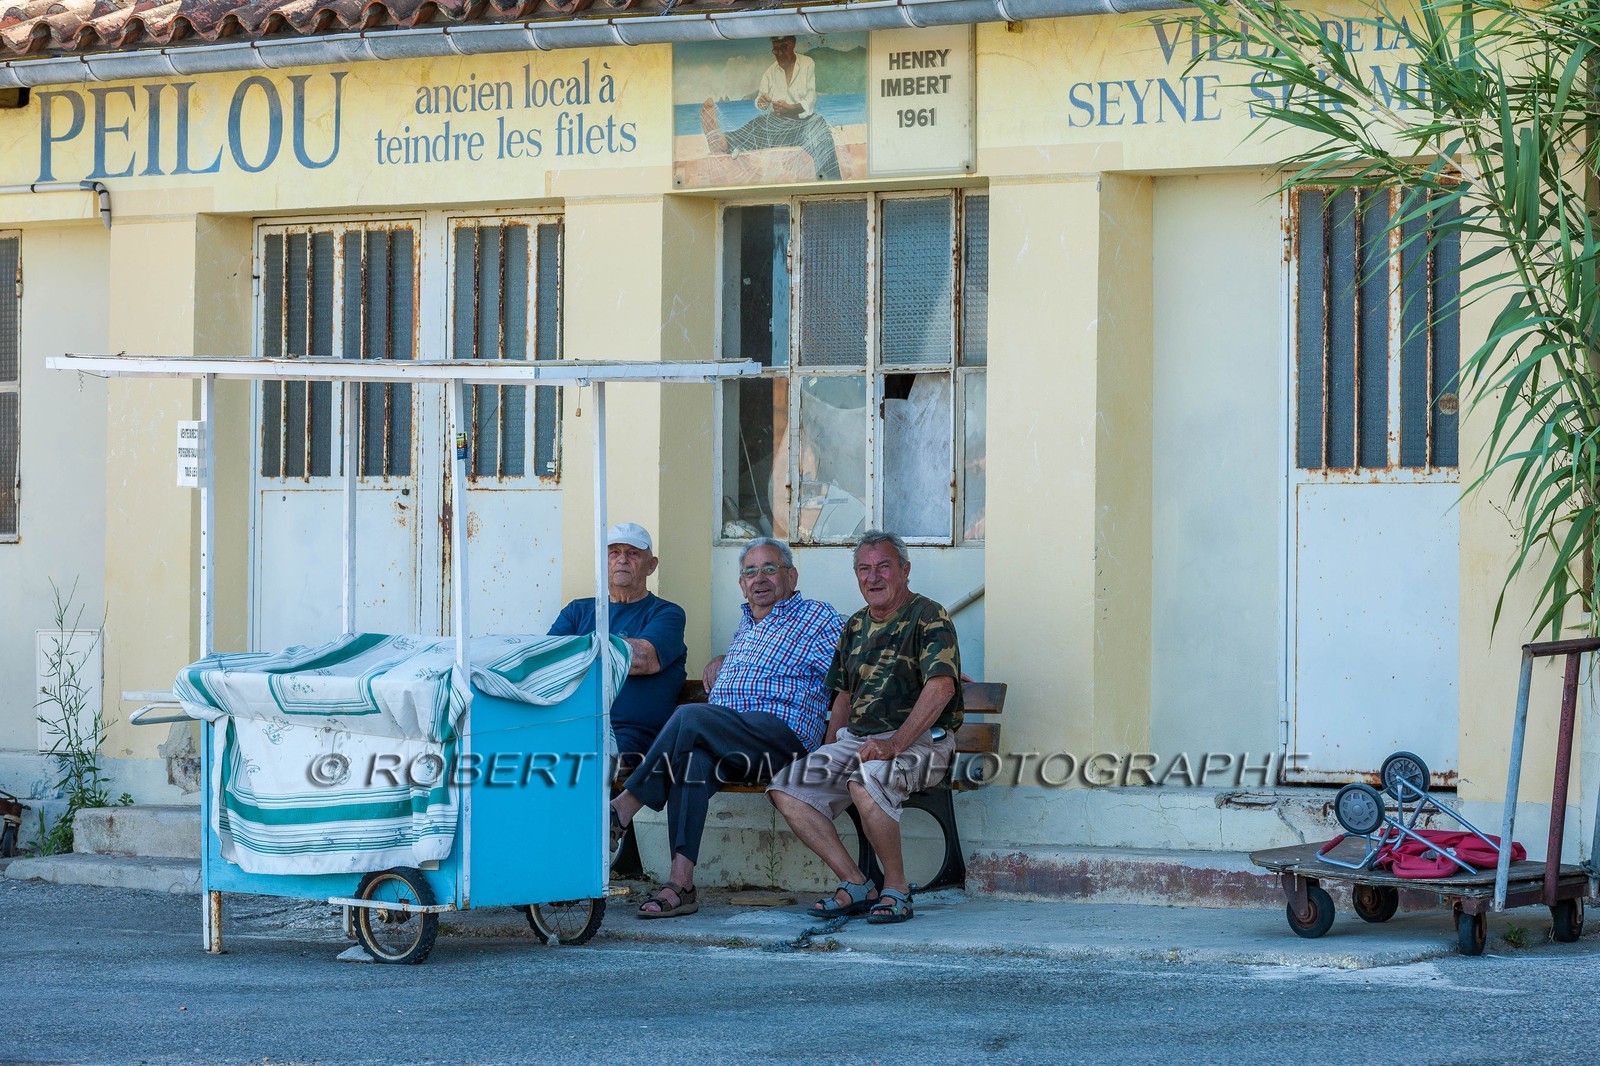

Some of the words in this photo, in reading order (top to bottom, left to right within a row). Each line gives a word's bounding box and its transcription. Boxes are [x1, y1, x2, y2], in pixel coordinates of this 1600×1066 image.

[1317, 18, 1364, 54] DE
[1373, 14, 1416, 51] LA
[889, 49, 950, 70] HENRY
[415, 73, 513, 114] ancien
[523, 58, 590, 108] local
[599, 62, 615, 103] à
[880, 75, 951, 98] IMBERT
[1068, 75, 1222, 127] SEYNE
[34, 71, 349, 183] PEILOU
[374, 120, 485, 165] teindre
[496, 116, 543, 159] les
[555, 111, 637, 156] filets
[896, 107, 936, 128] 1961
